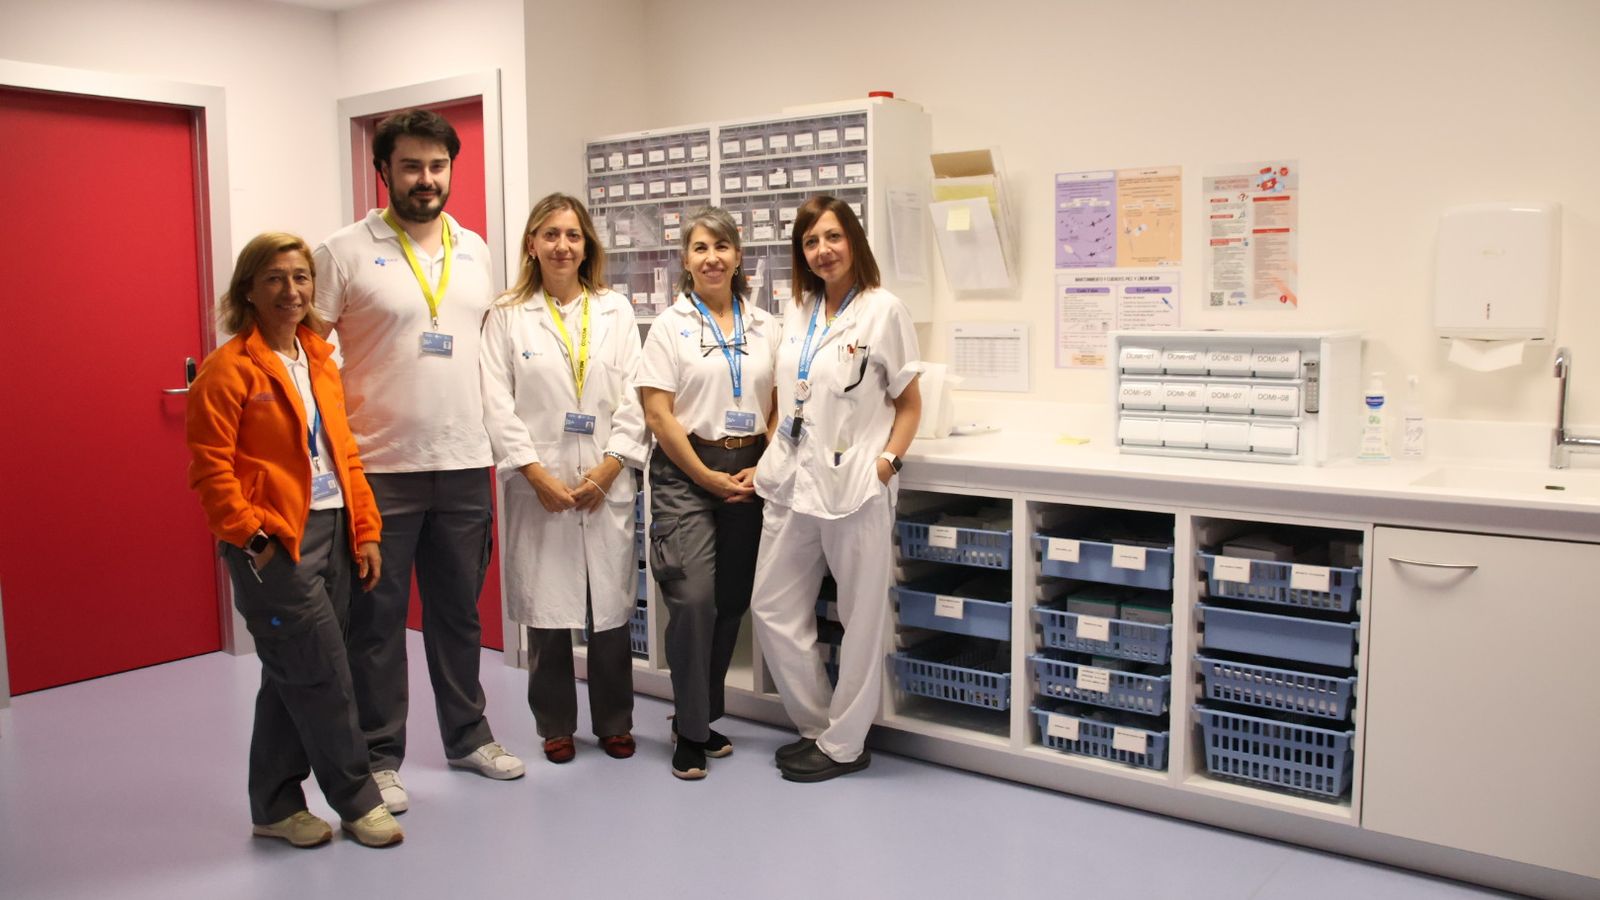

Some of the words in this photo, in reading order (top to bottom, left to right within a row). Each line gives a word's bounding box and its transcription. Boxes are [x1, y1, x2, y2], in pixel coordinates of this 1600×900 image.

[1211, 354, 1242, 362] DOMI-03
[1257, 356, 1289, 364] DOMI-04
[1211, 391, 1242, 400] DOMI-07
